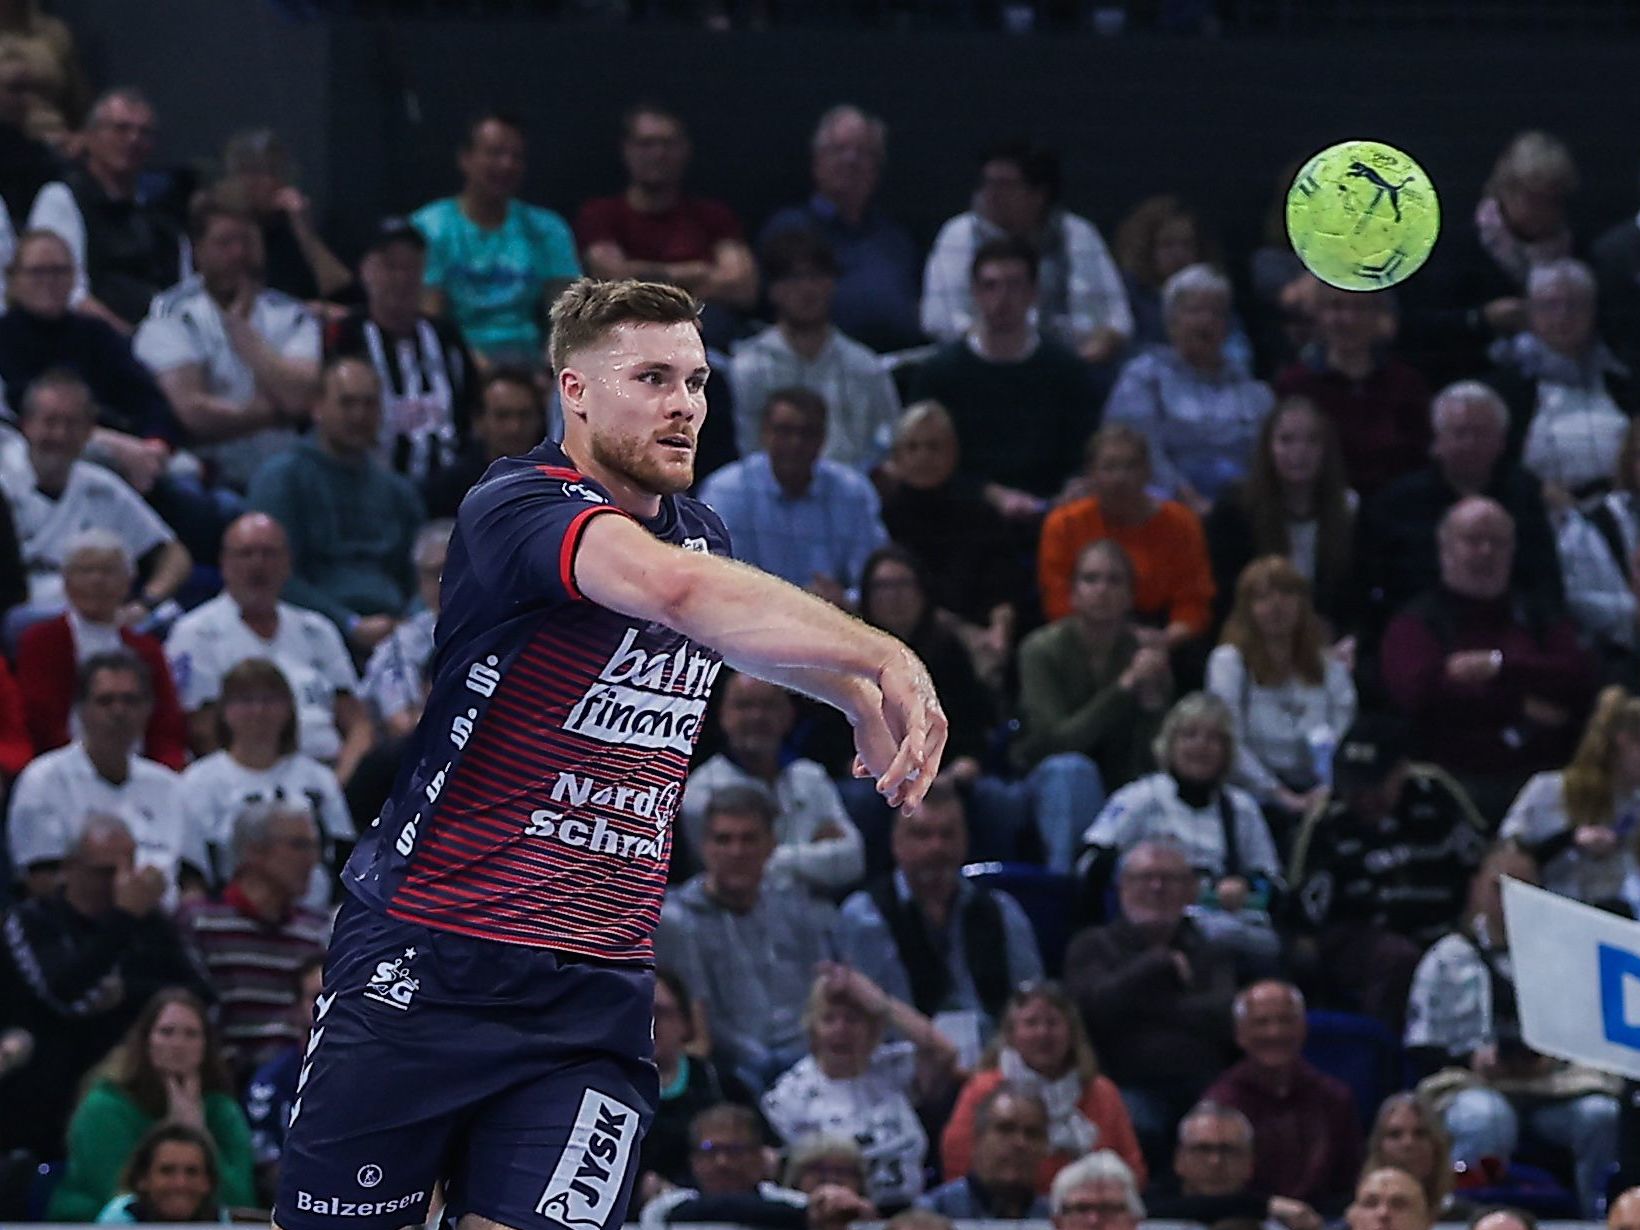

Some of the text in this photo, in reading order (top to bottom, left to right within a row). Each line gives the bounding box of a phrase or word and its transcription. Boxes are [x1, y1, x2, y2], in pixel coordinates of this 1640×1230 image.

[550, 771, 658, 819] Nord
[568, 1101, 628, 1209] JYSK
[297, 1190, 424, 1217] Balzersen
